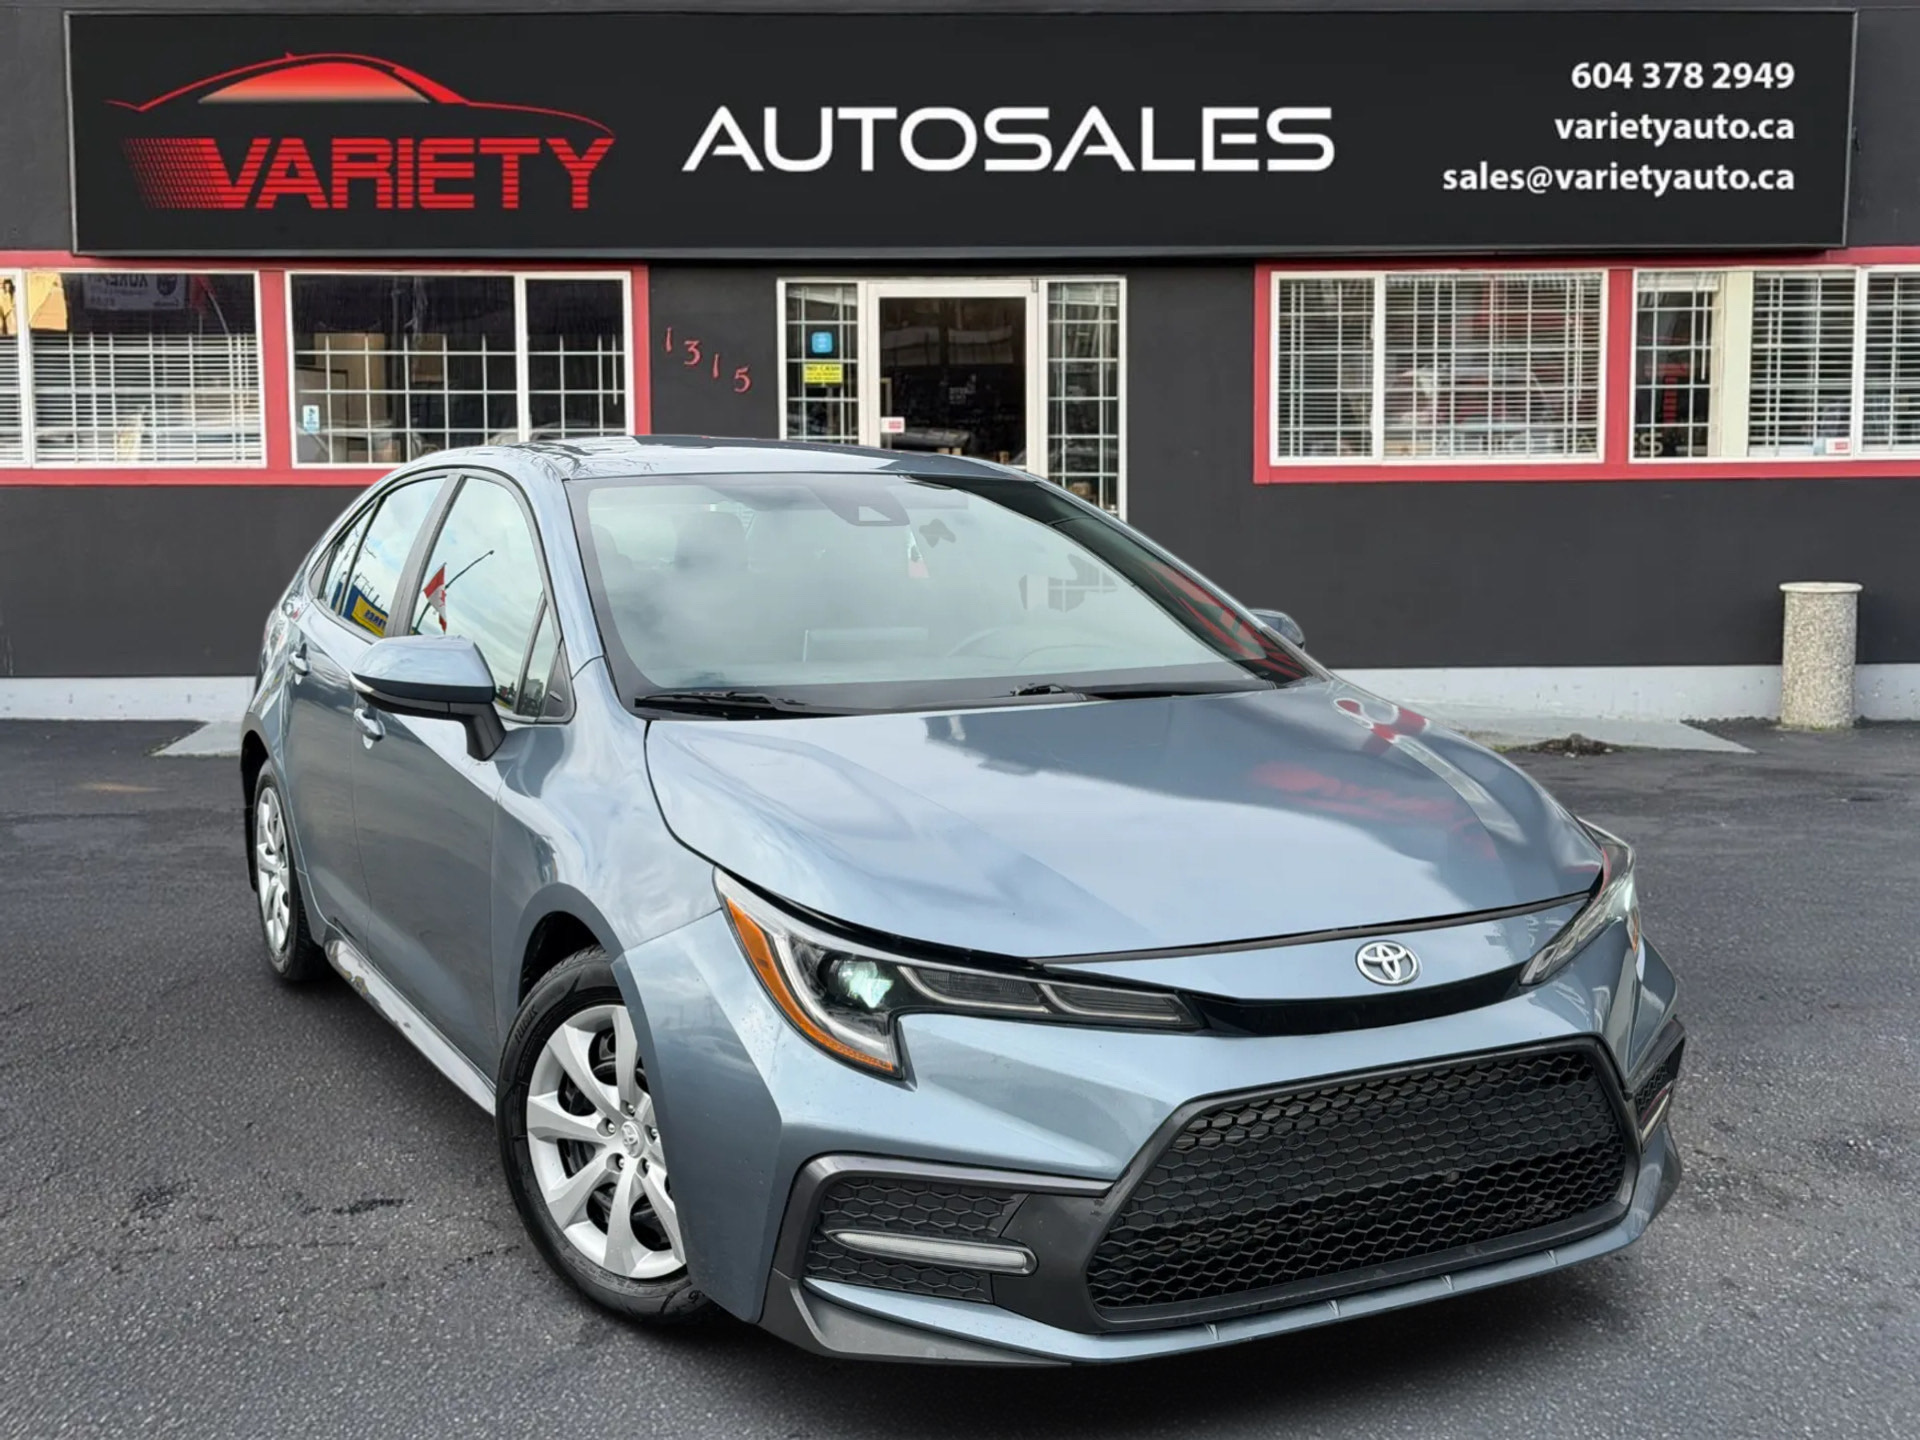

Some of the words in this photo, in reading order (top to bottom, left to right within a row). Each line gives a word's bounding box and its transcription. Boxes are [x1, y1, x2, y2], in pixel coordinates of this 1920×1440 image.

[1571, 61, 1634, 89] 604
[1642, 61, 1704, 89] 378
[1711, 61, 1796, 89] 2949
[1554, 111, 1796, 147] varietyauto.ca
[160, 136, 615, 210] VARIETY
[1442, 160, 1796, 198] sales@varietyauto.ca
[665, 326, 753, 394] 1315
